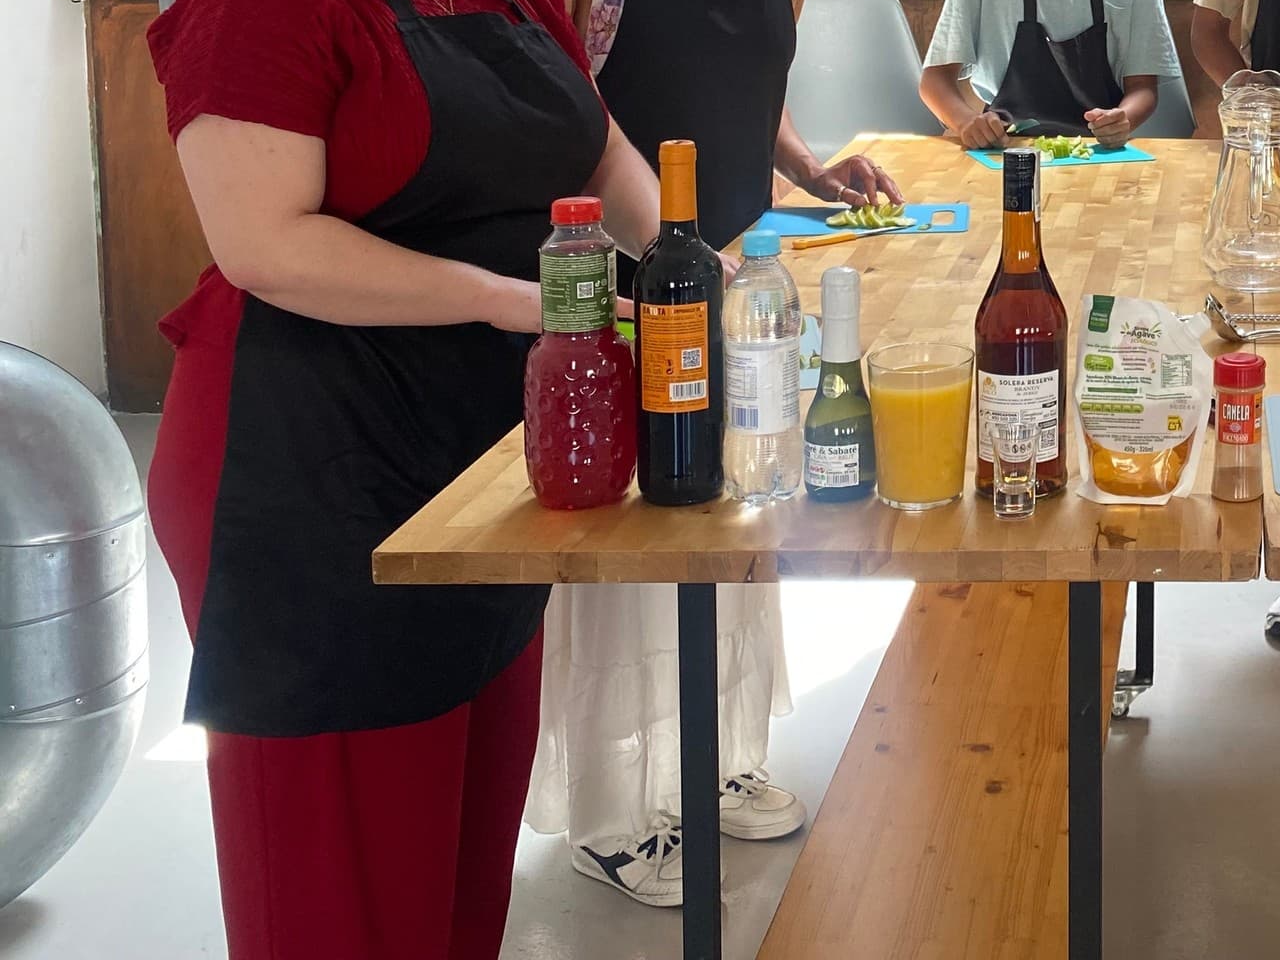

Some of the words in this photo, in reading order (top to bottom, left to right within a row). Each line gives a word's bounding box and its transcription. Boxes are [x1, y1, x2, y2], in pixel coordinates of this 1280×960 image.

[1131, 329, 1156, 340] Agave
[1027, 375, 1054, 385] RESERVA
[1222, 403, 1250, 421] CANELA
